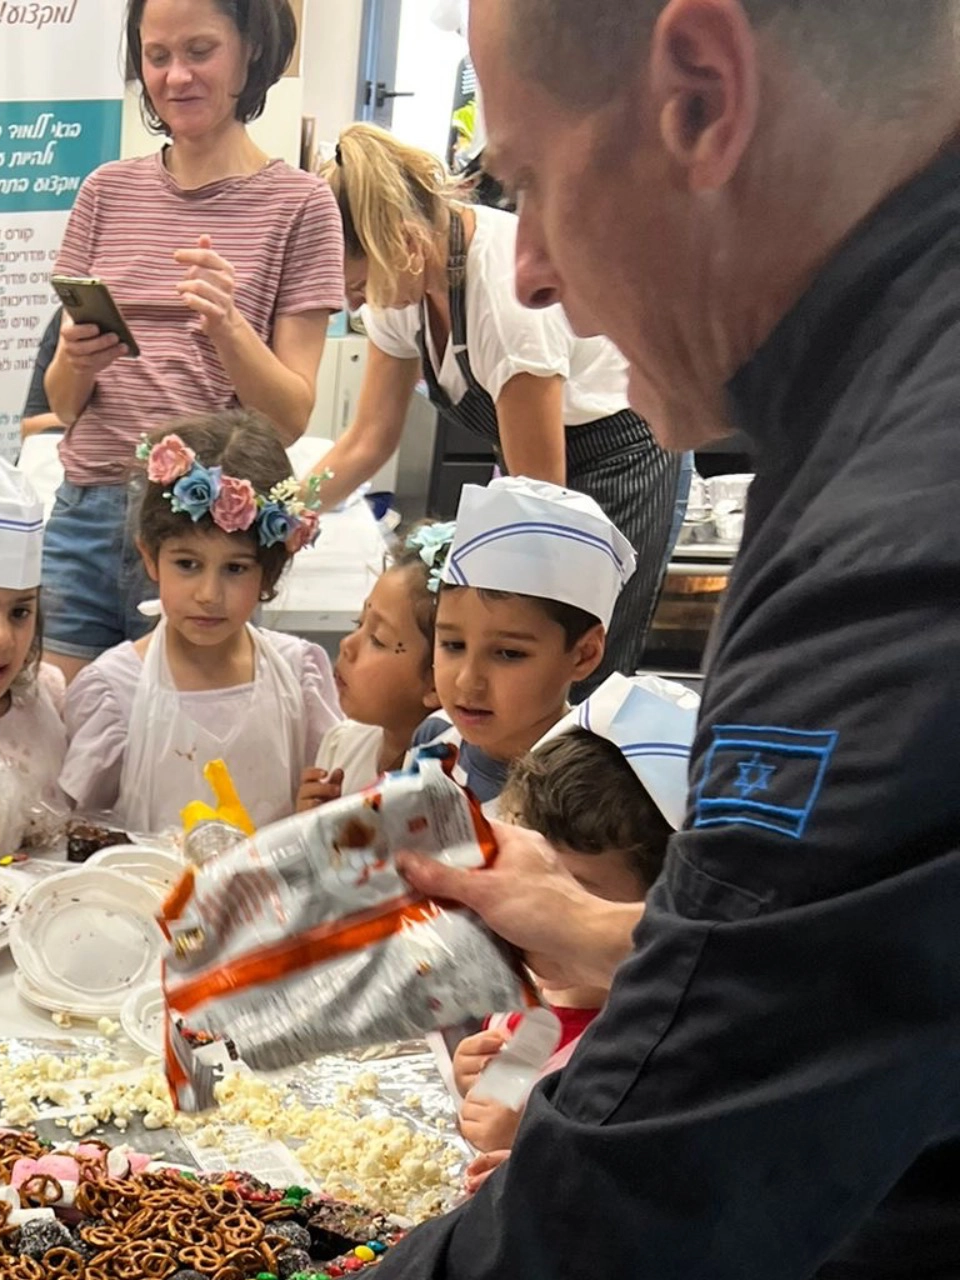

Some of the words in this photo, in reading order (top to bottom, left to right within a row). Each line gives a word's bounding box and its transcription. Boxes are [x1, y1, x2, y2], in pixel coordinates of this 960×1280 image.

[8, 113, 54, 140] ללמוד
[50, 121, 82, 138] בואי
[4, 228, 35, 243] קורס
[29, 271, 51, 284] ורס
